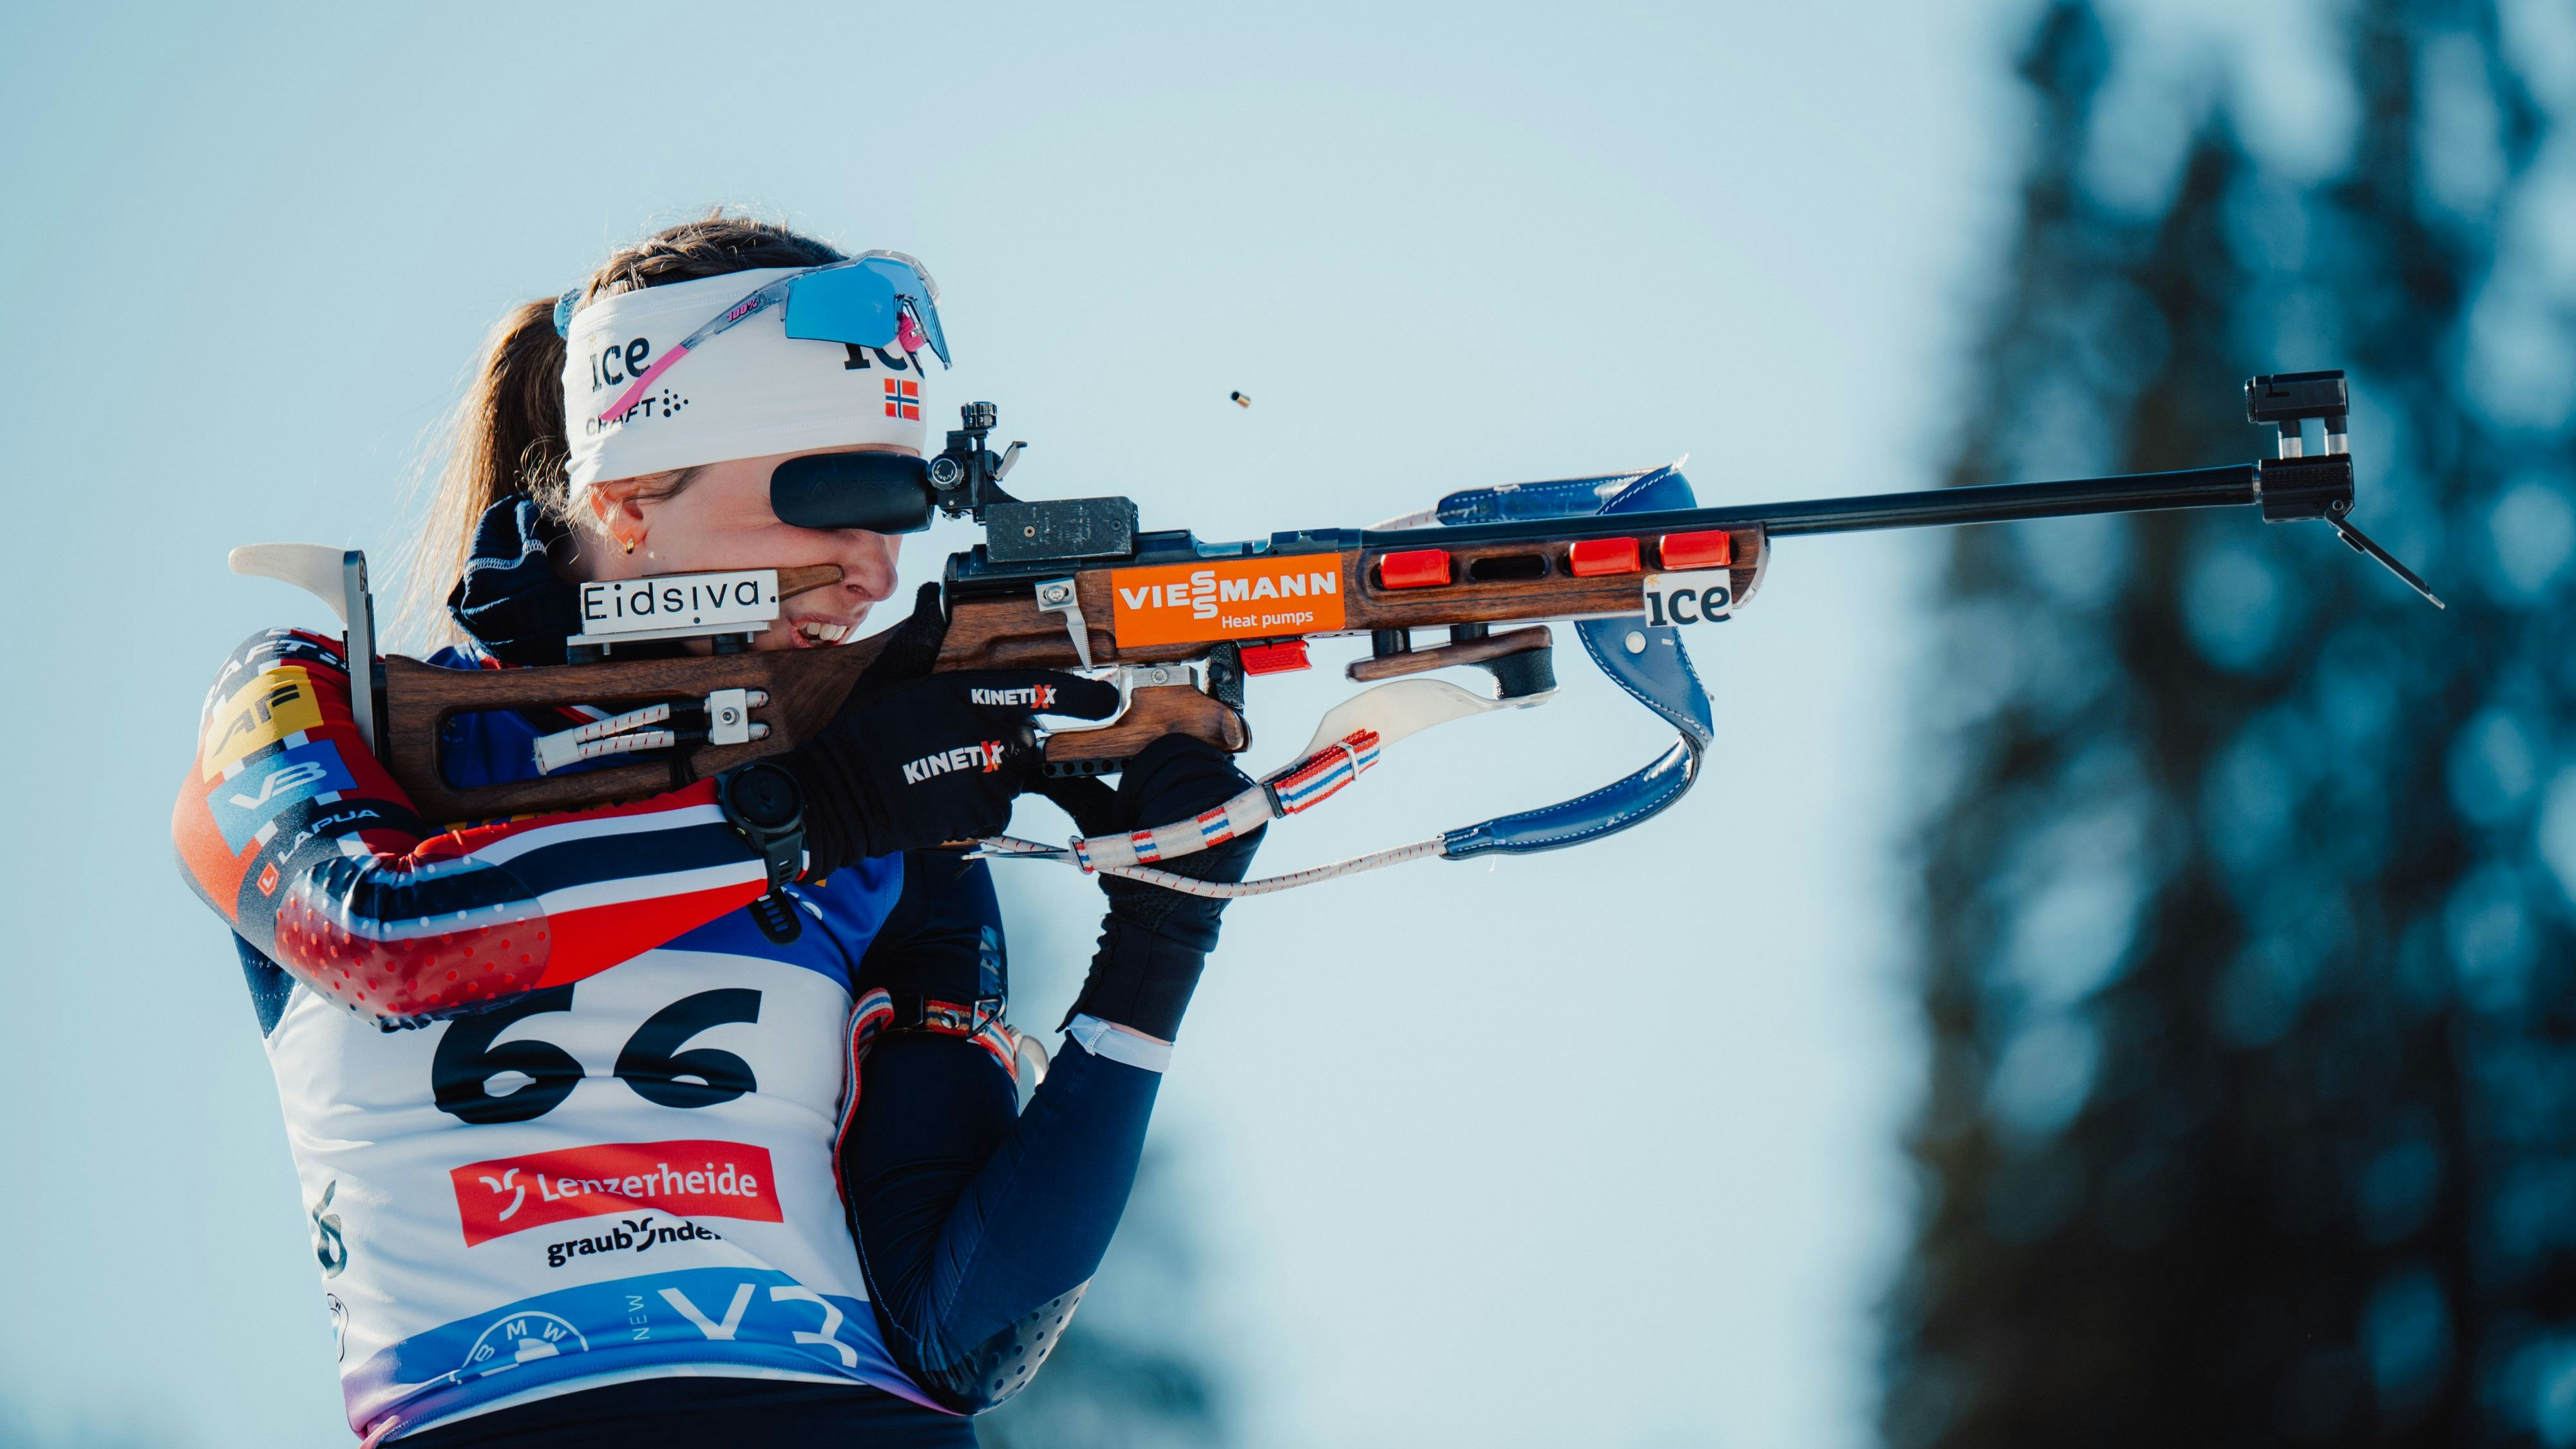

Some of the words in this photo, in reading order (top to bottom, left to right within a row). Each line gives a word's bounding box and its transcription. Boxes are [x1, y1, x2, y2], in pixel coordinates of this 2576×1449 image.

[726, 298, 759, 323] 100%
[1119, 570, 1337, 620] VIESSMANN
[1645, 585, 1732, 627] ice
[1222, 614, 1258, 629] Heat
[1262, 611, 1314, 629] pumps
[277, 809, 381, 865] LAPUA
[431, 981, 763, 1125] 66
[536, 1162, 758, 1202] Lenzerheide
[625, 1294, 650, 1341] NEW
[473, 1318, 567, 1363] BMW
